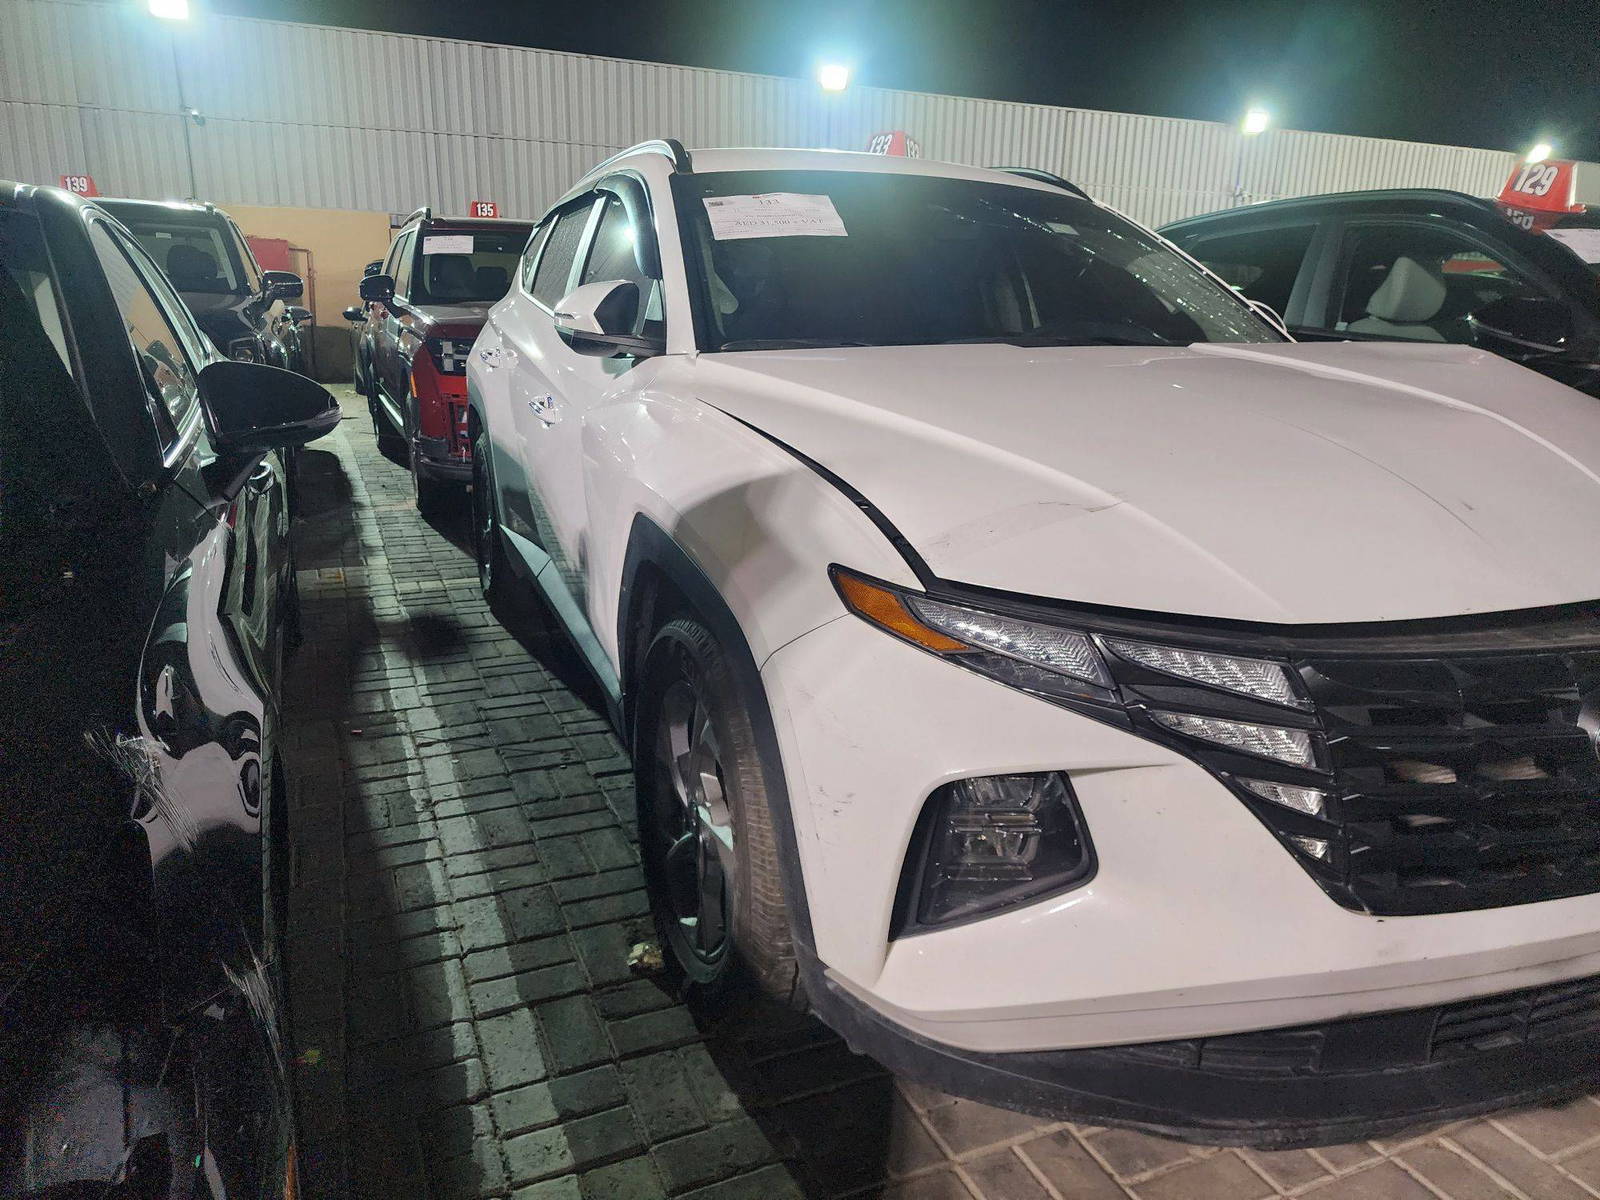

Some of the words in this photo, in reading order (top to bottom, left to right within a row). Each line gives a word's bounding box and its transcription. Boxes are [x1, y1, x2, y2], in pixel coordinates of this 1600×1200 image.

[869, 134, 893, 155] 133
[65, 176, 88, 193] 139
[1513, 163, 1559, 197] 129
[476, 203, 494, 217] 135
